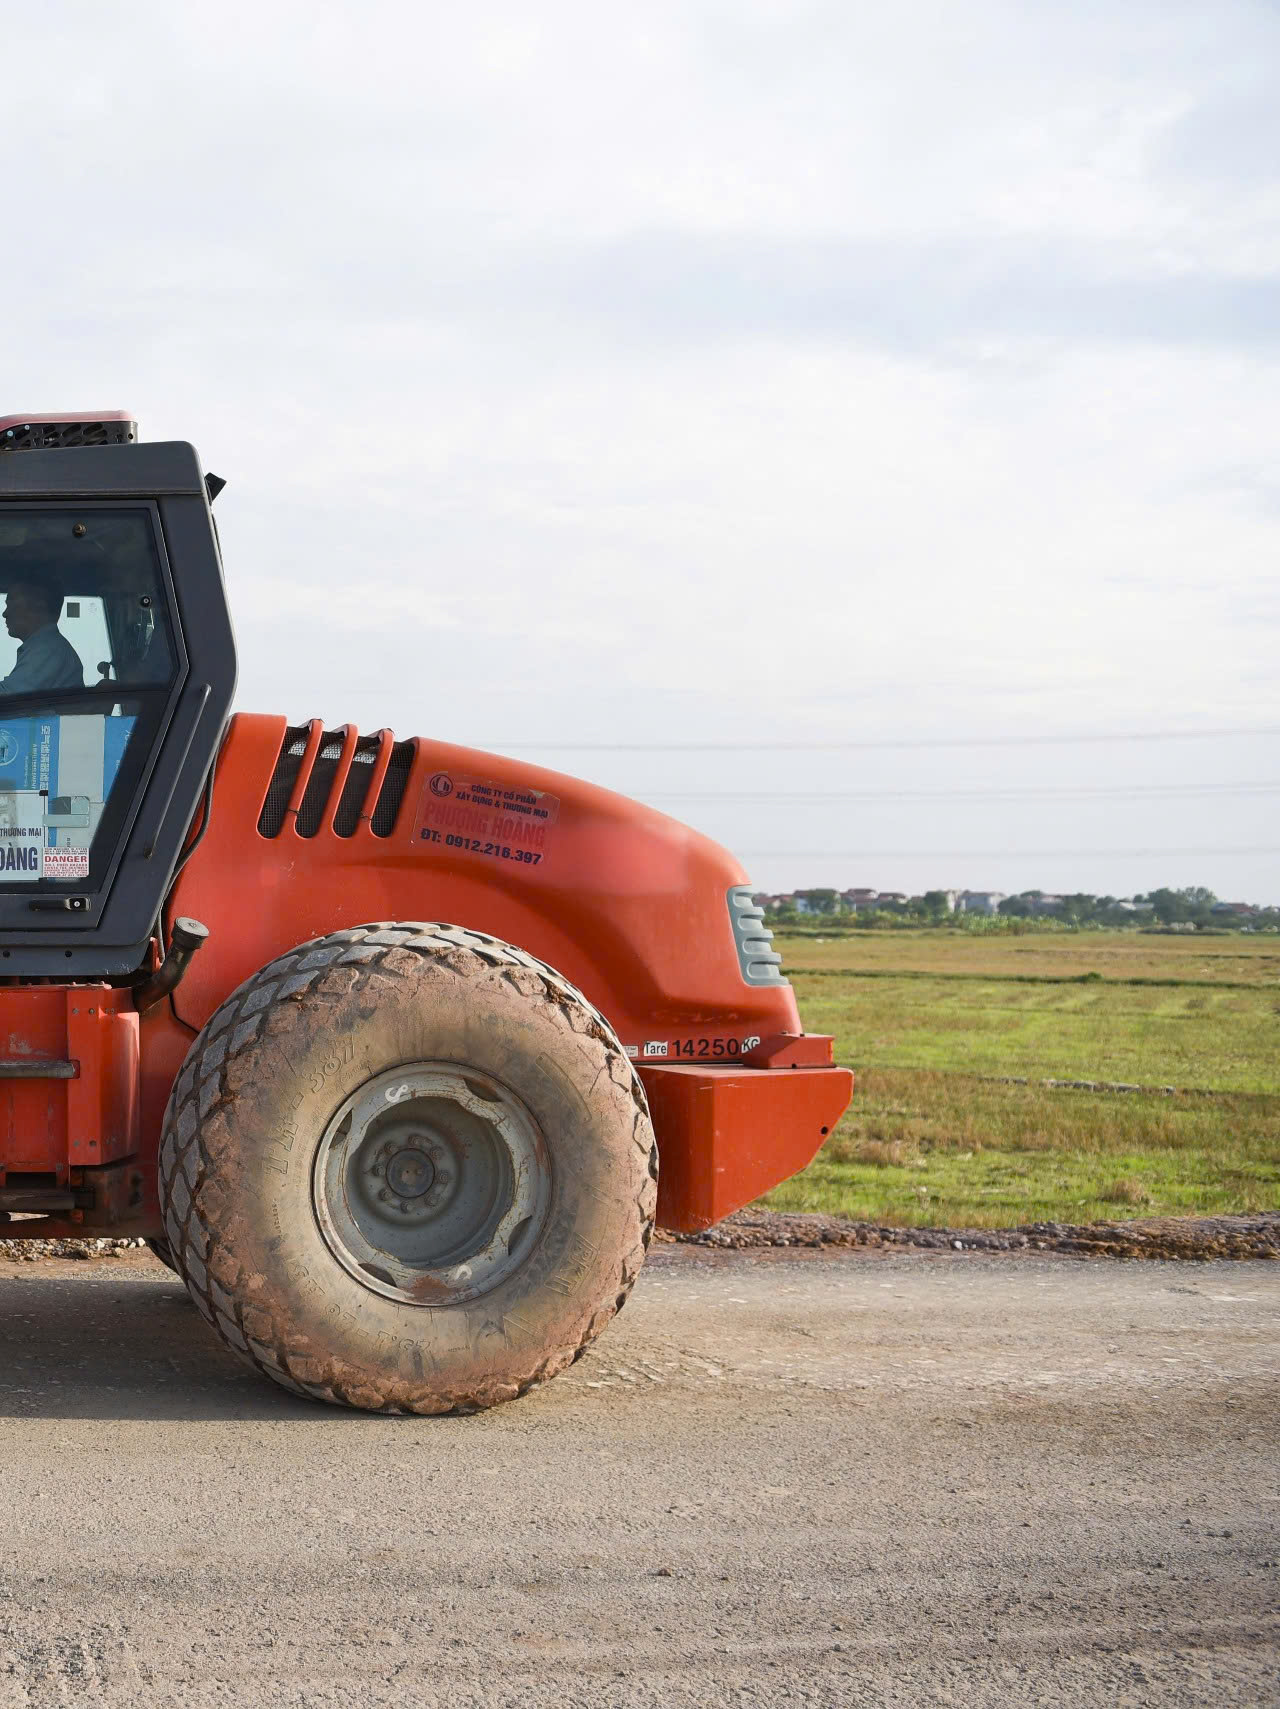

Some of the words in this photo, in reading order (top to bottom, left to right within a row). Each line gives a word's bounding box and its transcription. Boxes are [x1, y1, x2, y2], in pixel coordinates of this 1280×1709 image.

[493, 789, 503, 798] TY
[494, 799, 500, 808] &
[28, 827, 42, 839] MẠI
[44, 855, 88, 863] DANGER
[645, 1042, 667, 1055] Tare
[672, 1038, 740, 1057] 14250
